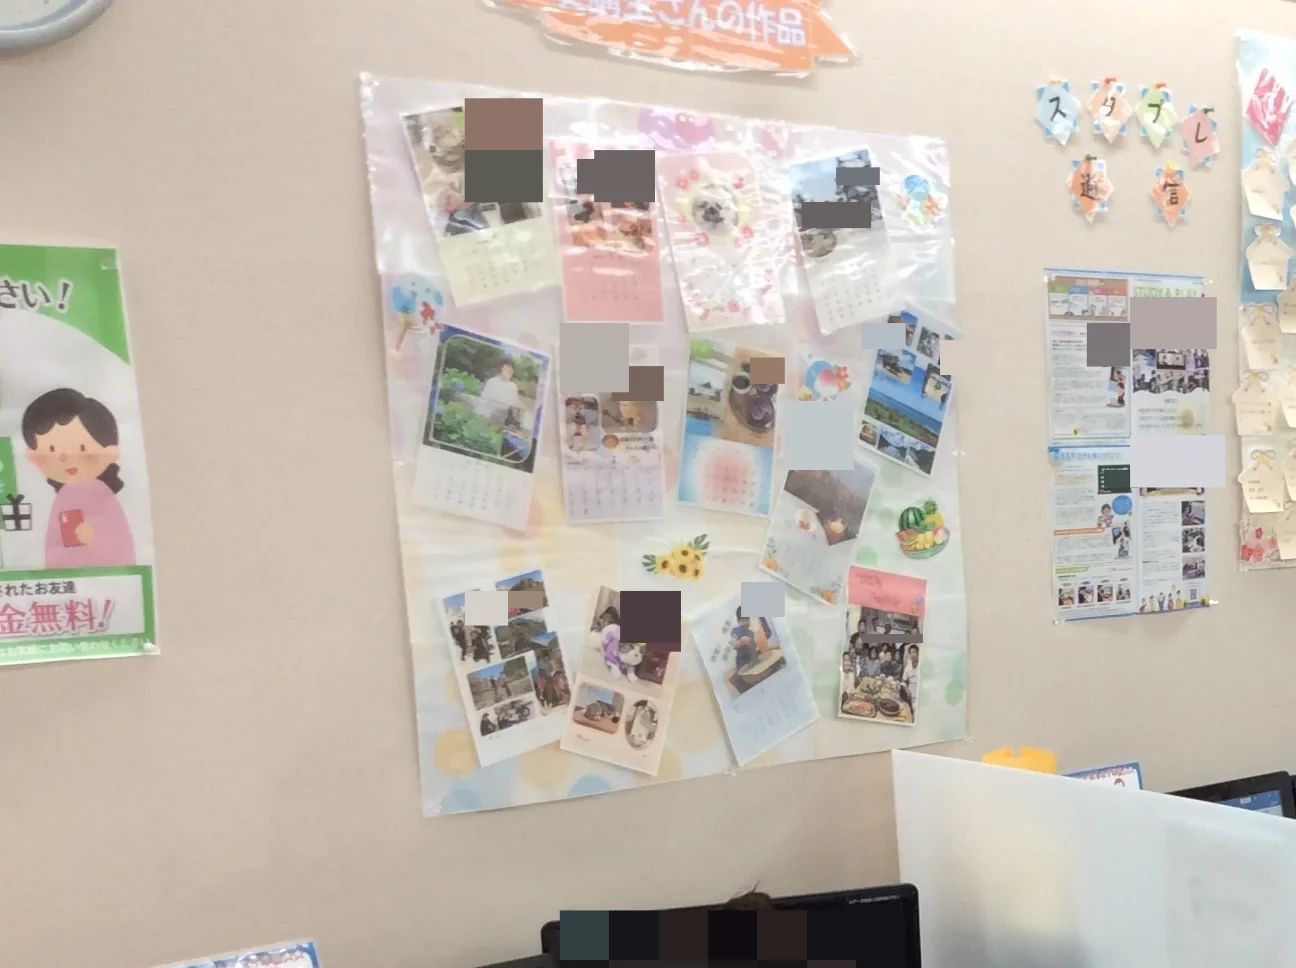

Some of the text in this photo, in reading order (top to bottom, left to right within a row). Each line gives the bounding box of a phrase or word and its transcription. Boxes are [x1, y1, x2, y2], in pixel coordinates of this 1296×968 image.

[555, 0, 808, 46] 生さんの作品
[0, 599, 113, 635] 金無料!
